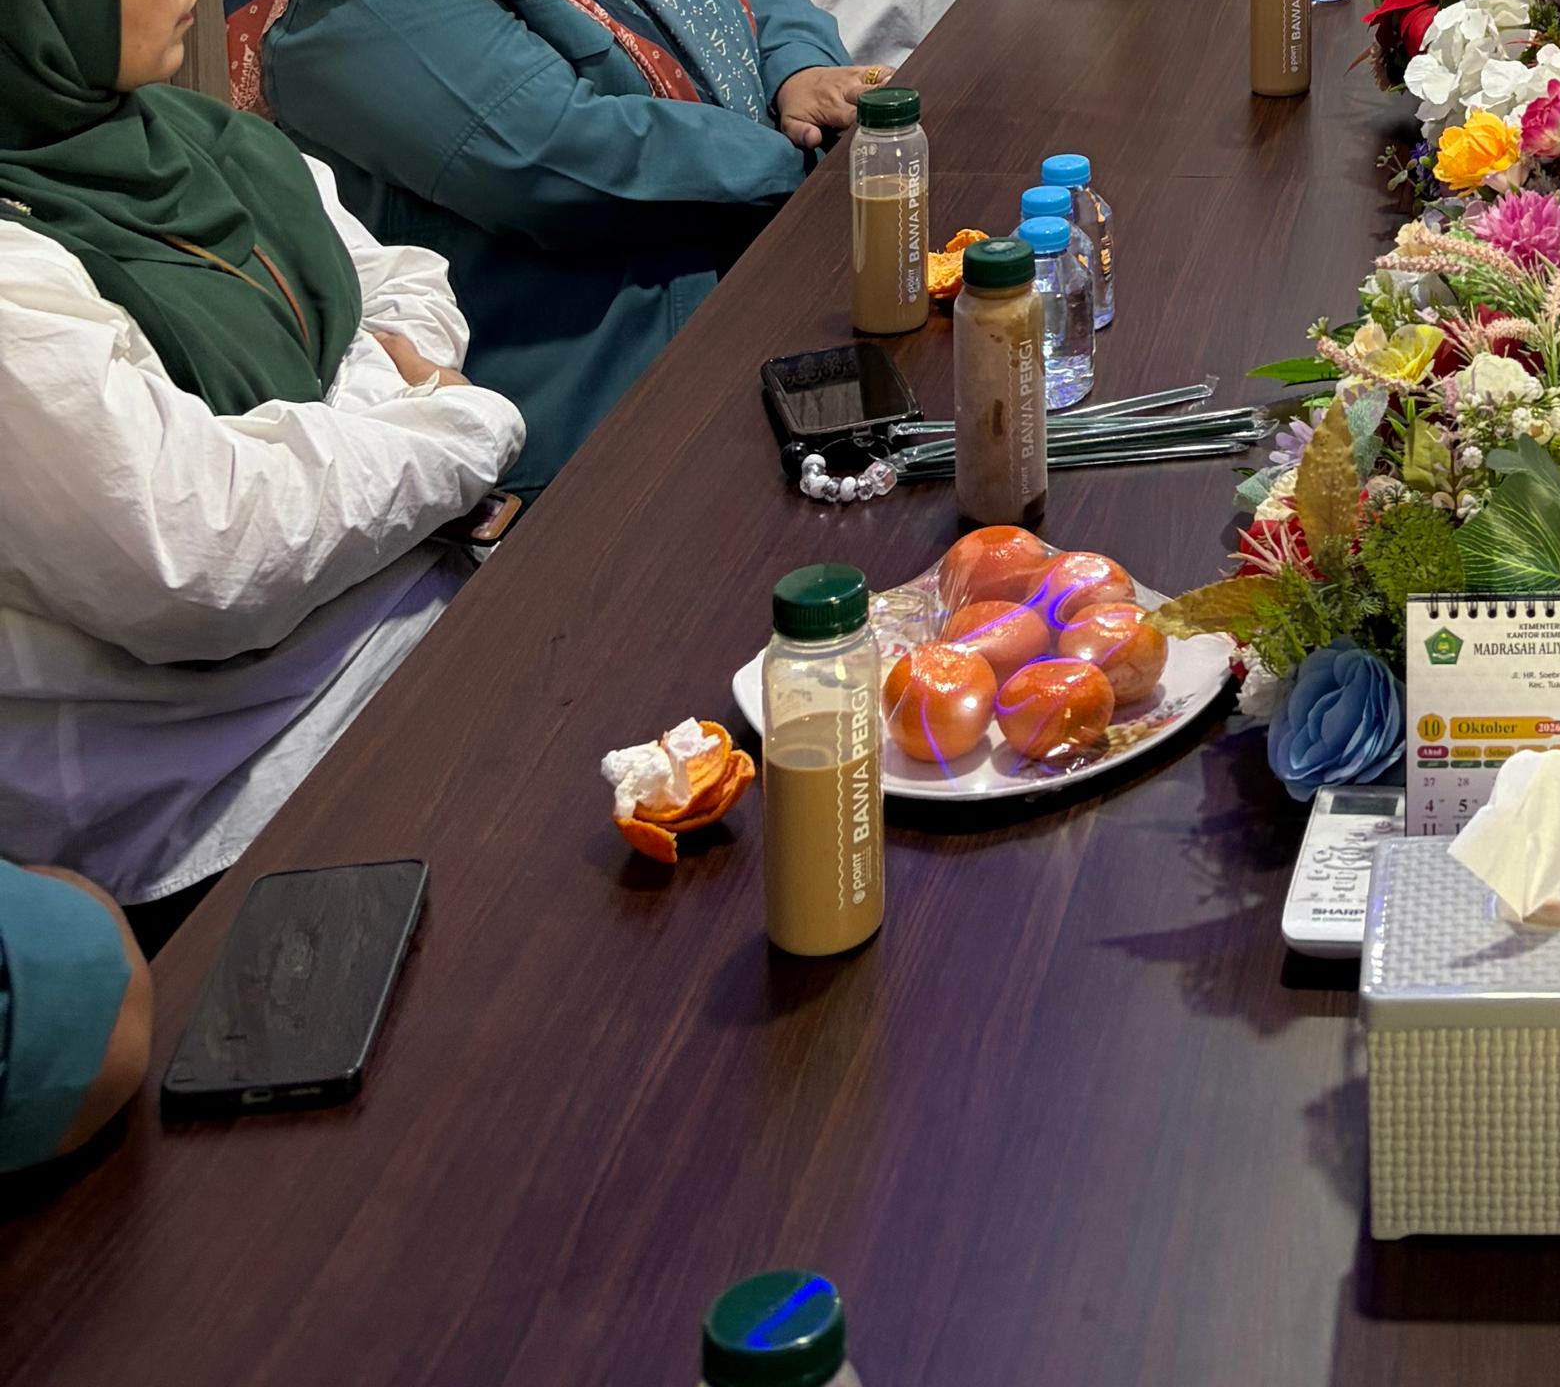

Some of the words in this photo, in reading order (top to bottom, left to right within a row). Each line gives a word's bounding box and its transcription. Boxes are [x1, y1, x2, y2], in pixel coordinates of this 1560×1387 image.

[908, 159, 920, 209] PERGI
[908, 211, 920, 262] BAWA
[1019, 338, 1033, 397] PERGI
[1021, 398, 1034, 459] BAWA
[1473, 642, 1536, 655] MADRASAH
[852, 683, 869, 761] PERGI
[1423, 719, 1441, 737] 10
[1457, 721, 1518, 734] Oktober
[1423, 777, 1436, 787] 27
[1457, 777, 1469, 787] 28
[853, 760, 870, 844] BAWA
[1425, 799, 1434, 812] 4
[1458, 799, 1468, 813] 5
[1423, 823, 1436, 835] 11
[1311, 908, 1365, 916] SHARP
